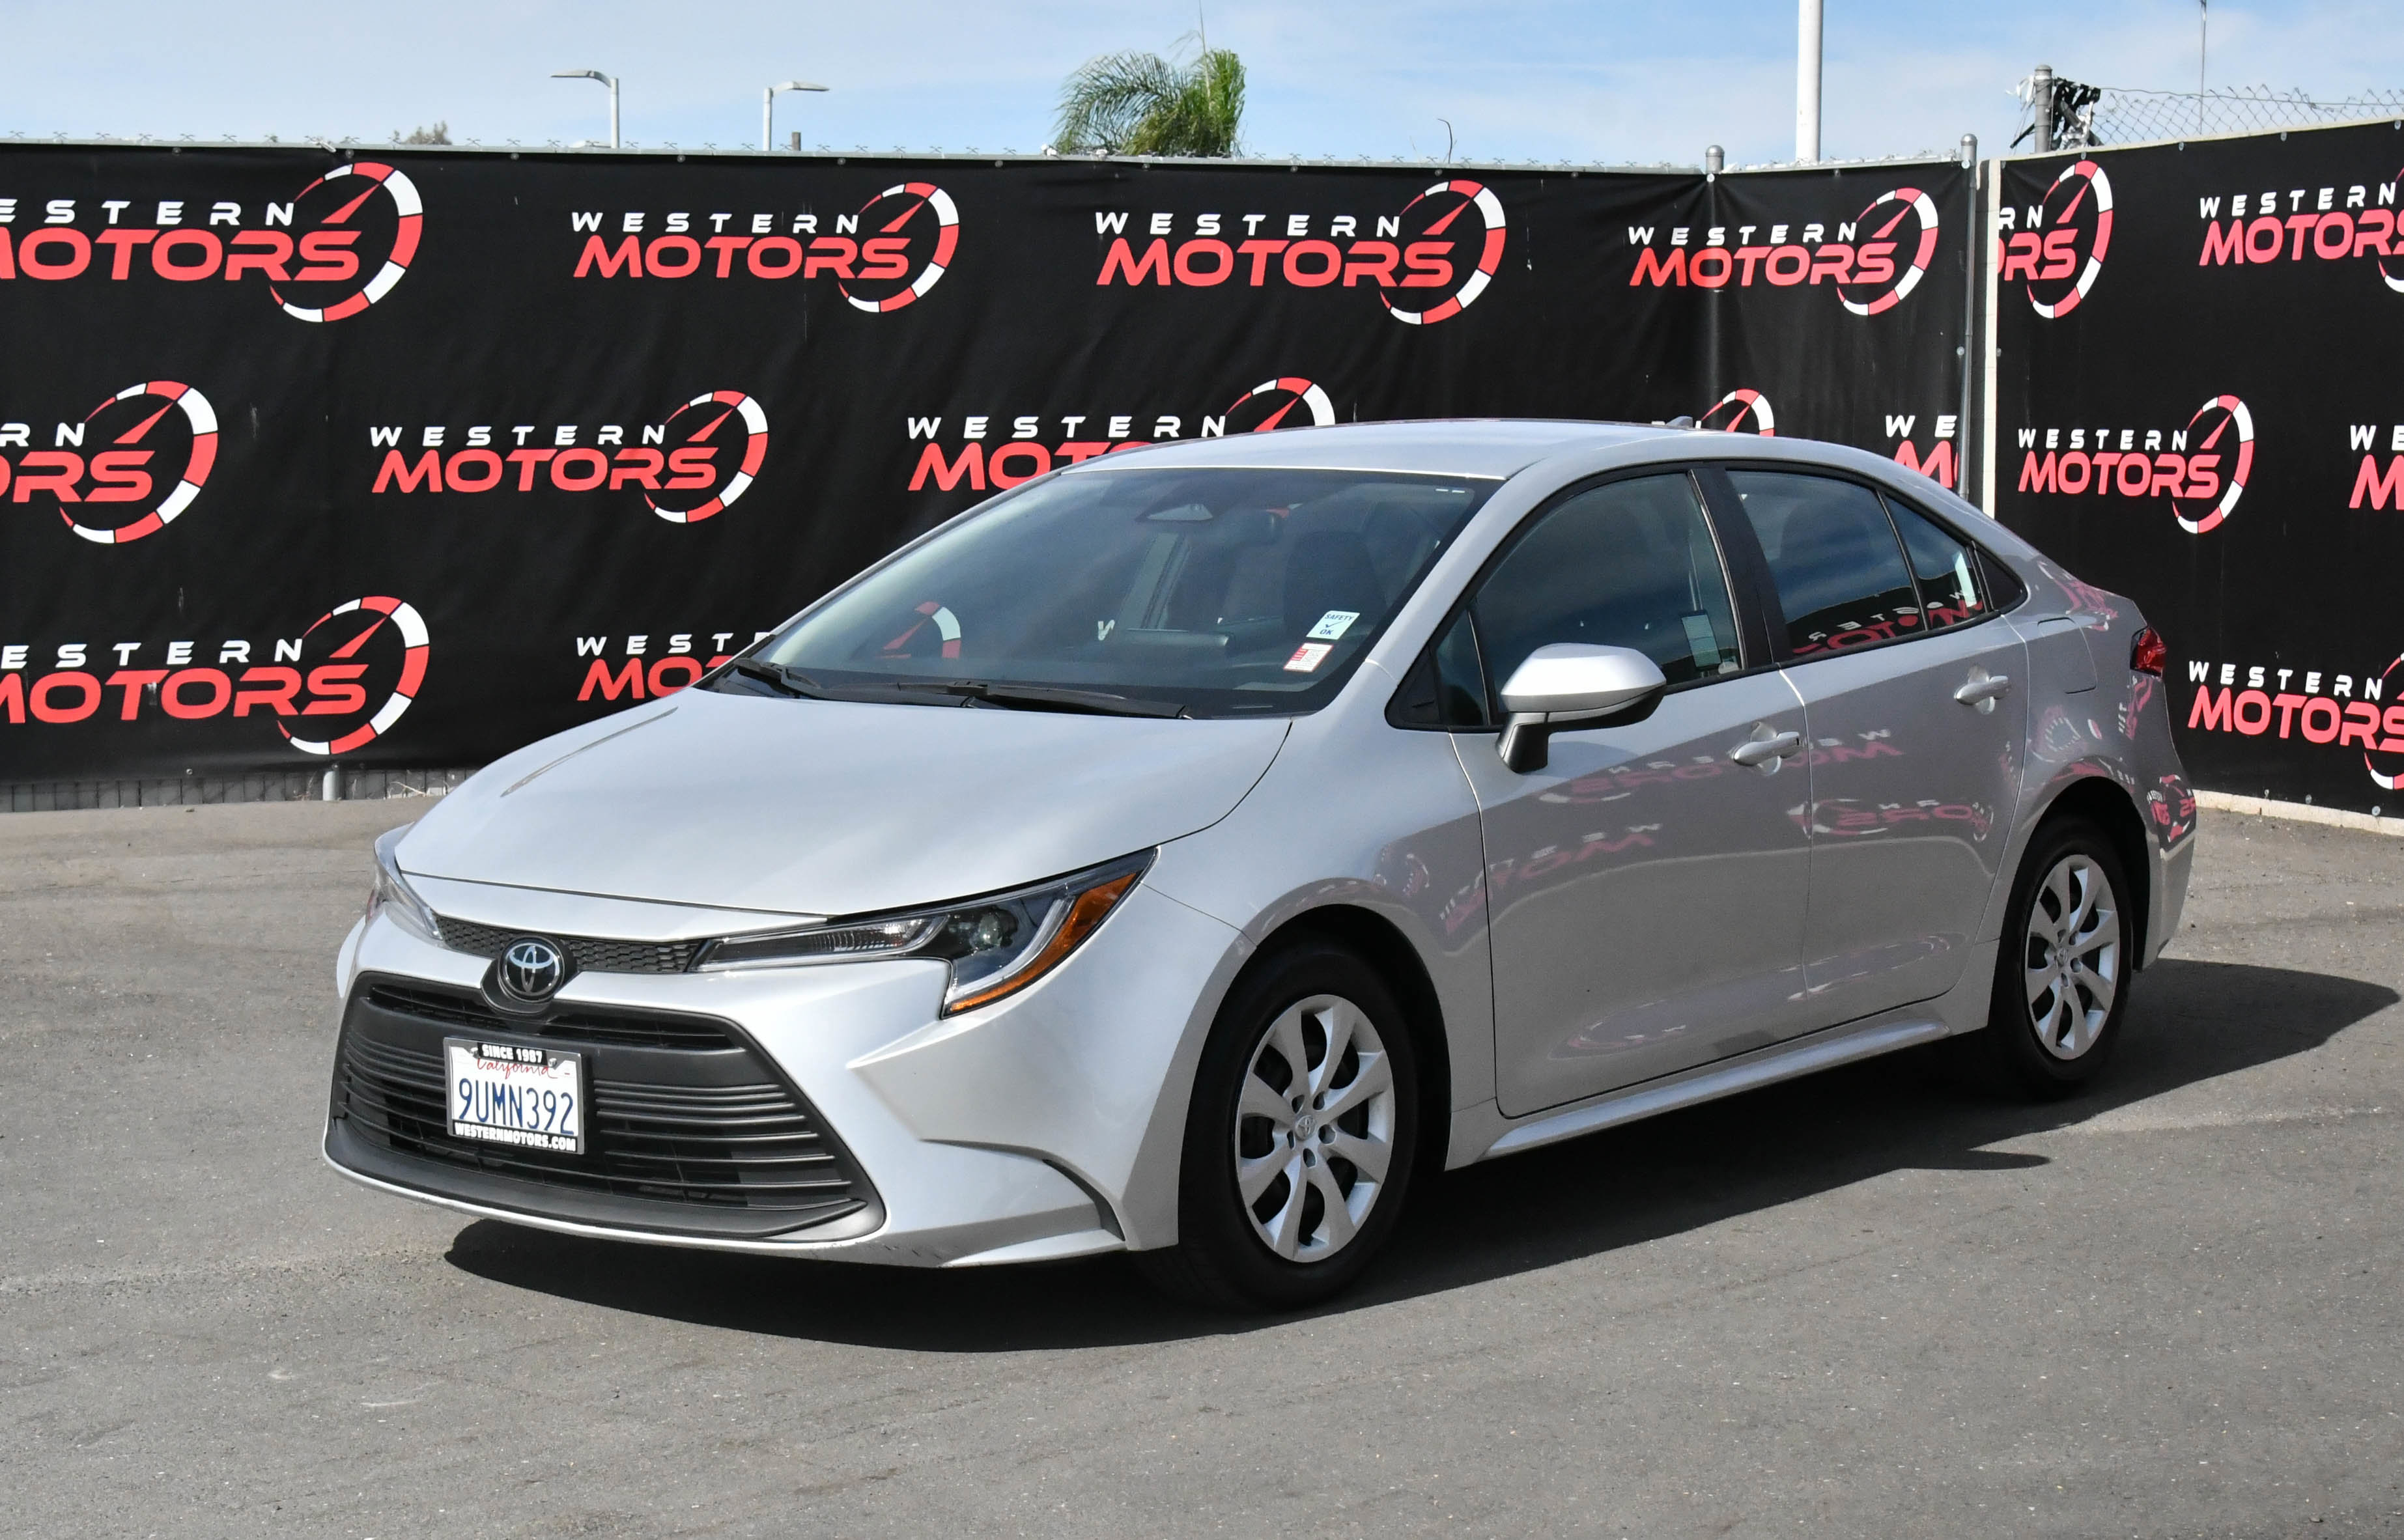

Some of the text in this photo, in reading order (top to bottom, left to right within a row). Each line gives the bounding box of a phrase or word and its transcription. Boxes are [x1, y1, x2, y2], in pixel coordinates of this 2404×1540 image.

[0, 199, 294, 226] ESTERN
[2200, 182, 2396, 218] WESTERN
[572, 212, 858, 233] WESTERN
[1096, 212, 1400, 237] WESTERN
[1628, 222, 1856, 246] WESTERN
[2199, 209, 2404, 266] MOTOR
[0, 227, 361, 281] OTORS
[573, 234, 911, 279] MOTORS
[1097, 238, 1455, 287] MOTORS
[1630, 244, 1897, 288] MOTORS
[1998, 229, 2078, 281] RS
[0, 423, 85, 447] RN
[371, 425, 664, 447] WESTERN
[908, 416, 1226, 438] WESTERN
[1886, 415, 1957, 438] WE
[2018, 428, 2187, 451] WESTERN
[0, 451, 155, 503] RS
[372, 447, 718, 493] MOTORS
[2018, 451, 2221, 499] MOTORS
[1, 639, 302, 669] ESTERN
[576, 655, 733, 701] MO
[2189, 660, 2383, 700] WESTERN
[482, 1044, 543, 1063] SINCE 1987
[459, 1078, 574, 1134] 9UMN392
[455, 1122, 576, 1152] WESTERNMOTORS.COM
